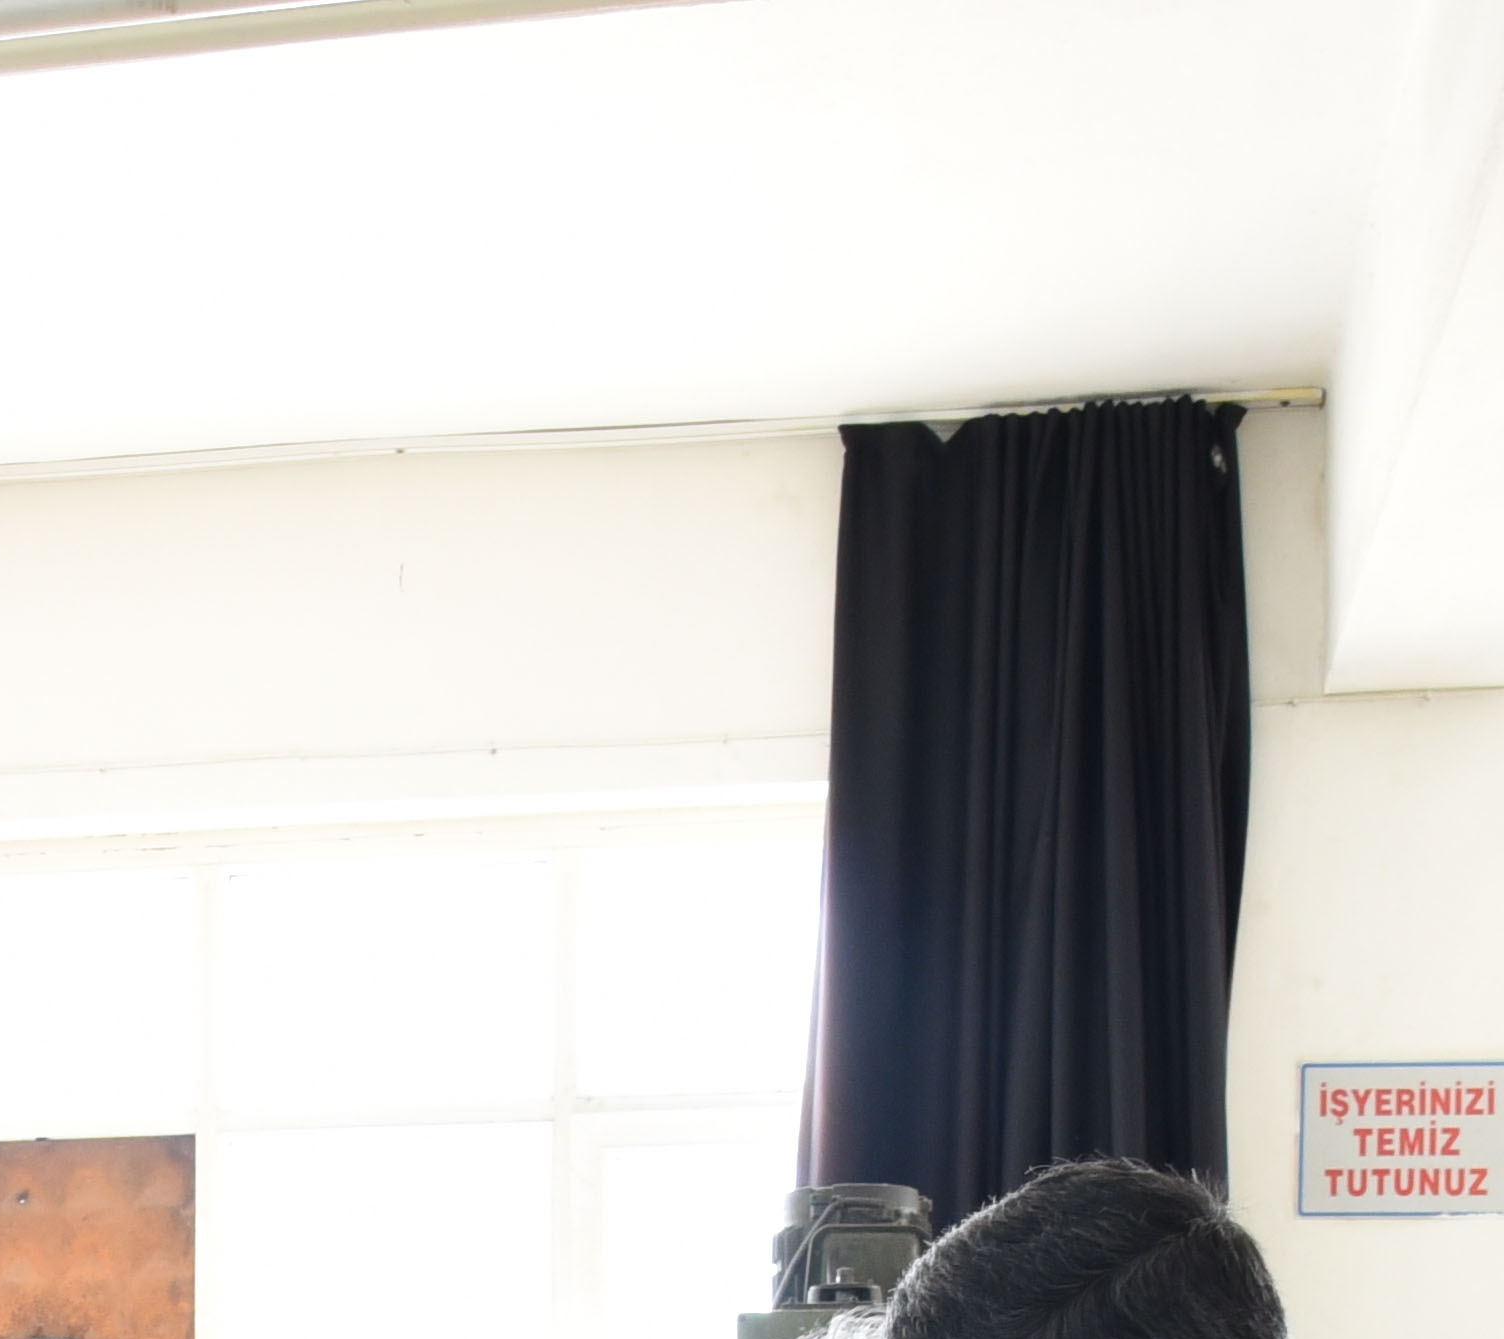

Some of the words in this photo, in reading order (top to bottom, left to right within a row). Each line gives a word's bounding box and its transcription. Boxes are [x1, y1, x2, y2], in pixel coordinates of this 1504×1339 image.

[1319, 1080, 1495, 1125] İŞYERİNİZİ
[1353, 1120, 1461, 1156] TEMİZ
[1325, 1168, 1489, 1197] TUTUNUZ
